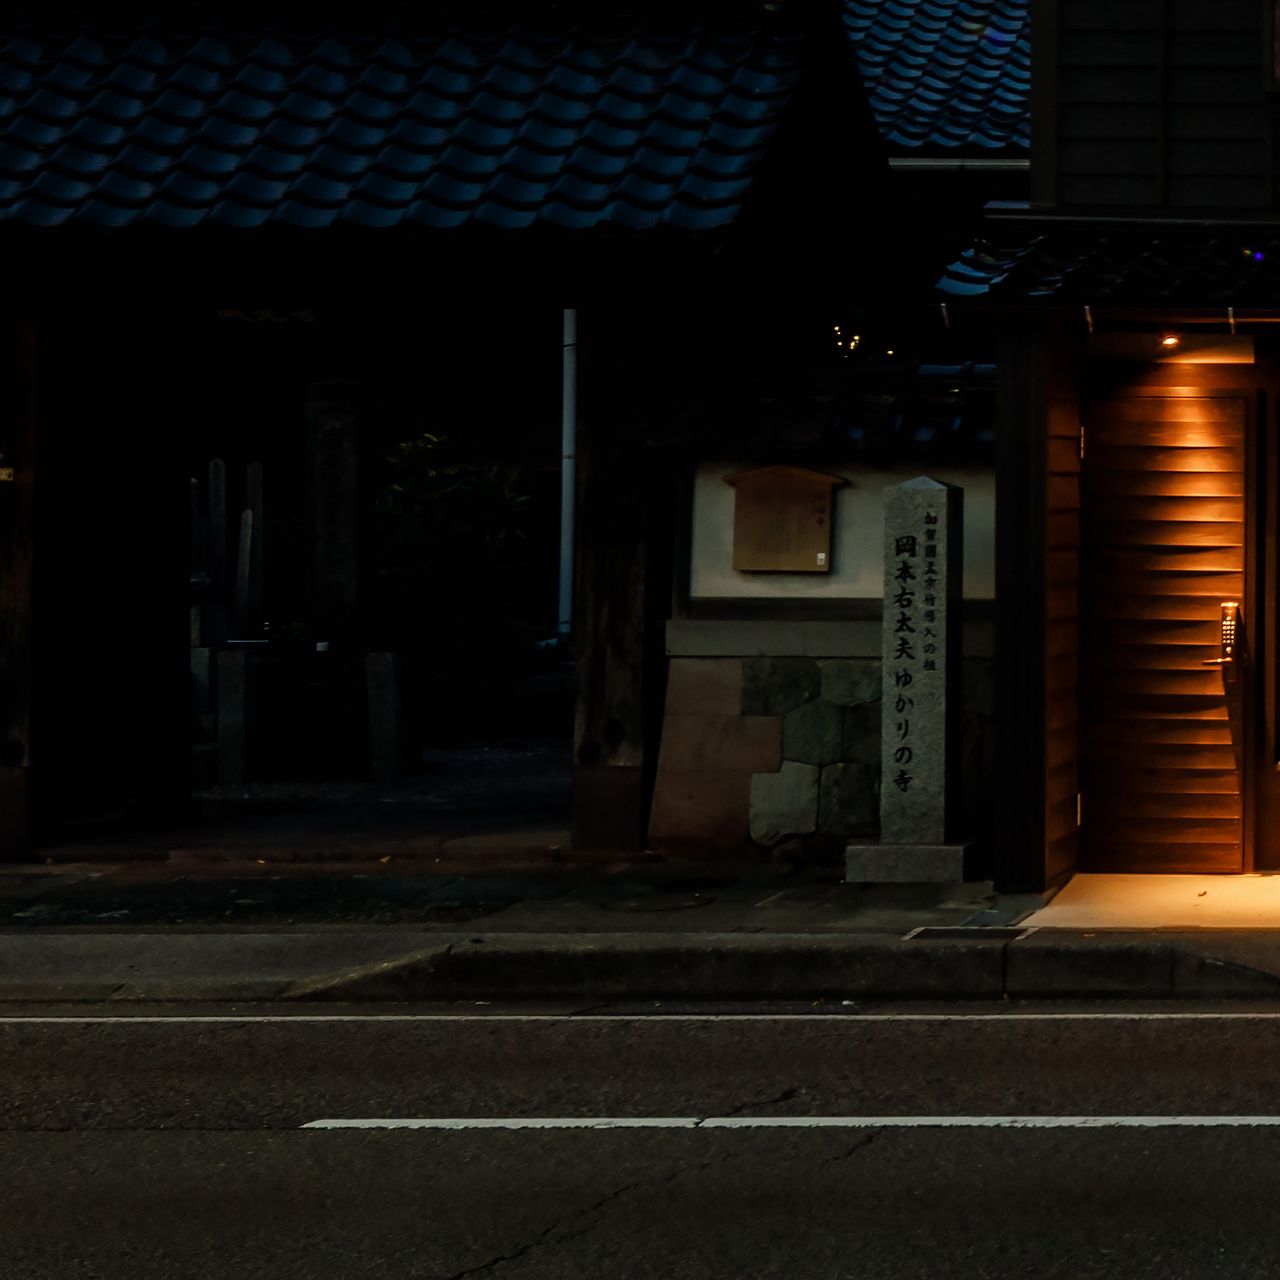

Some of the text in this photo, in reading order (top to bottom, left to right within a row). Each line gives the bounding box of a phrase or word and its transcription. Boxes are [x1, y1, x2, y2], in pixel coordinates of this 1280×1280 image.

[893, 535, 917, 793] 岡本右太夫ゆかりの寺
